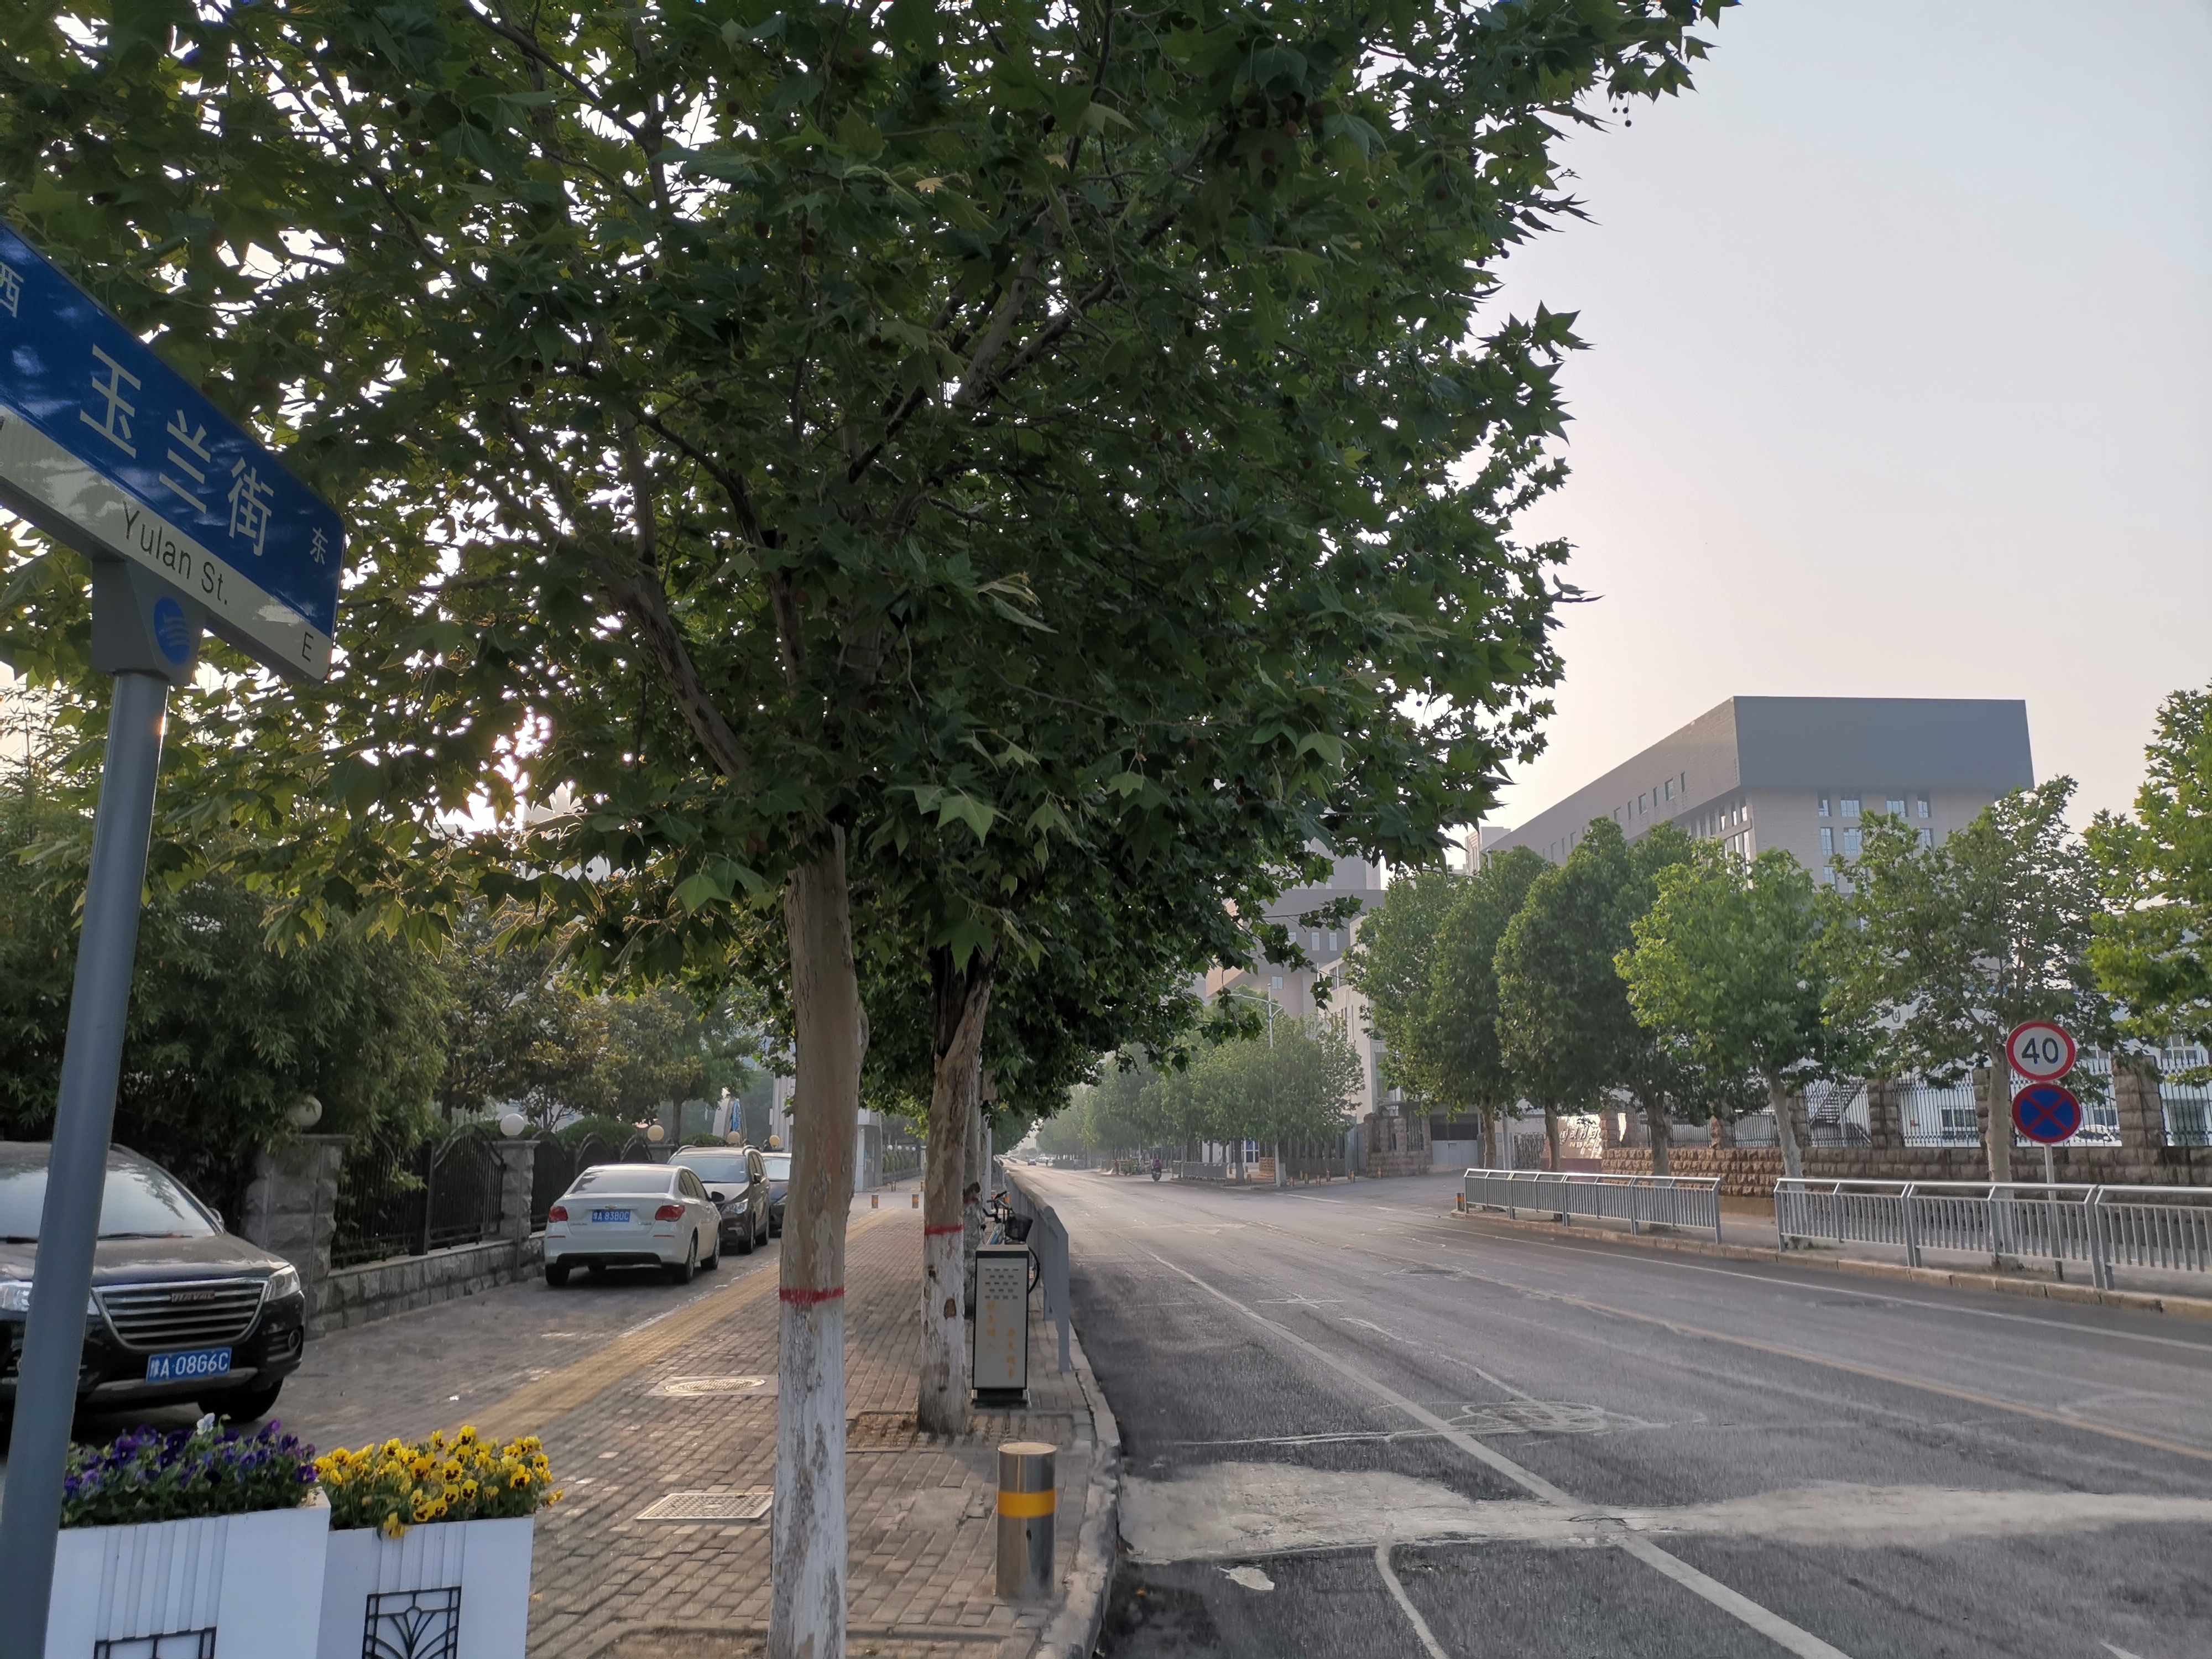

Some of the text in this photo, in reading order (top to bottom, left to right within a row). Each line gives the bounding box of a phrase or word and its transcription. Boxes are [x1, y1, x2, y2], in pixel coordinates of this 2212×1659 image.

[80, 343, 273, 556] 玉兰街
[123, 500, 228, 606] Yulan St.
[310, 526, 328, 565] 东
[301, 630, 314, 662] E
[2021, 1037, 2059, 1064] 40
